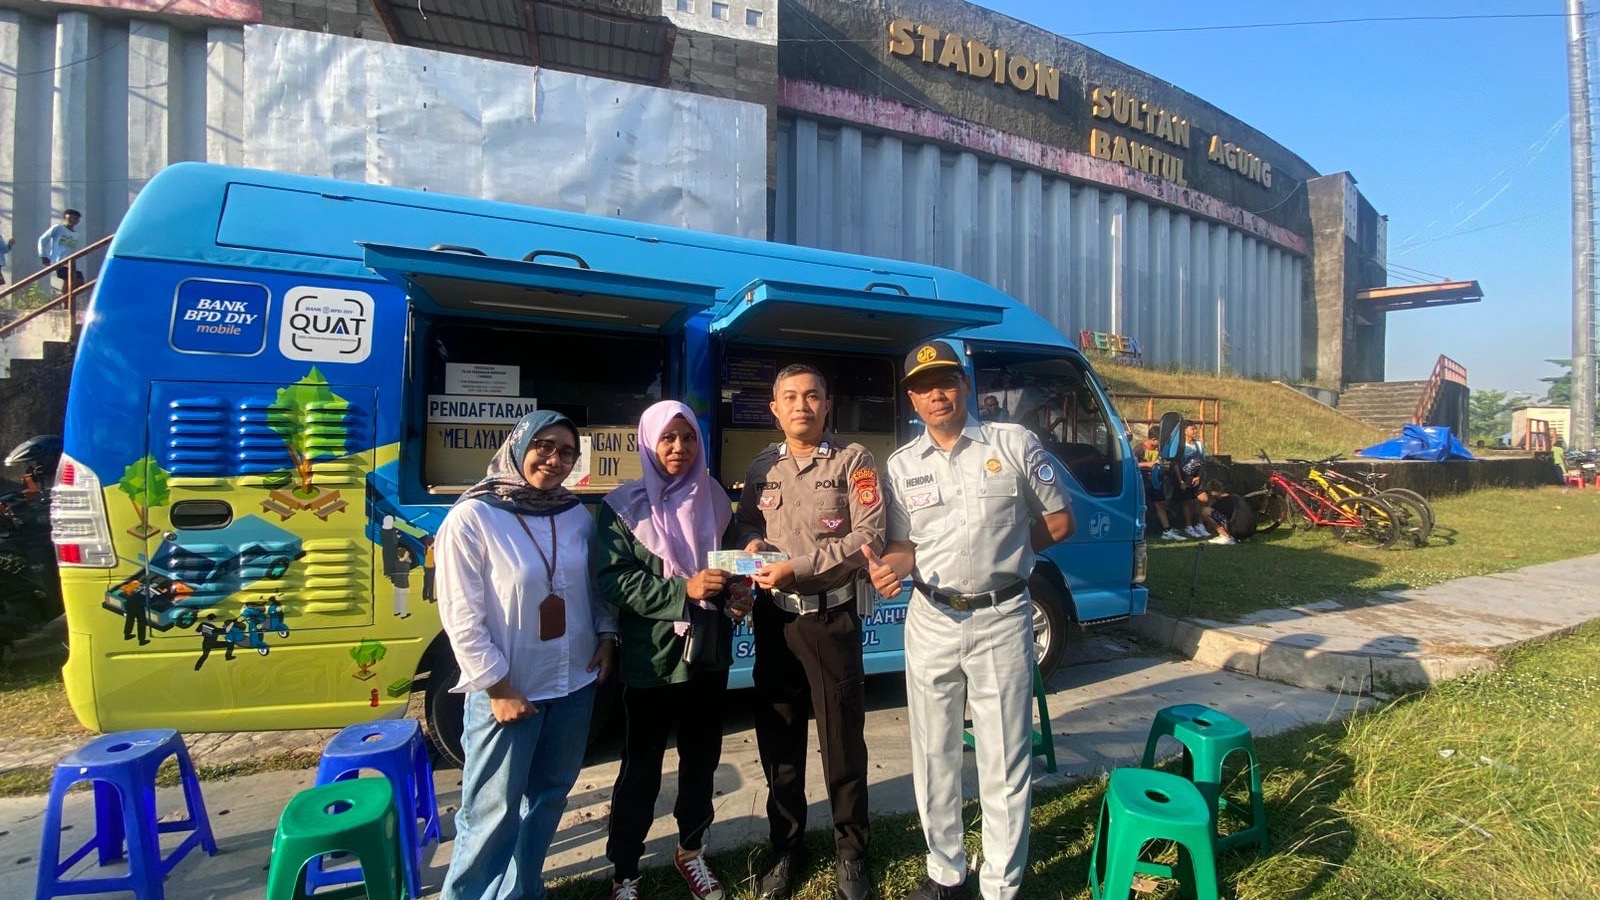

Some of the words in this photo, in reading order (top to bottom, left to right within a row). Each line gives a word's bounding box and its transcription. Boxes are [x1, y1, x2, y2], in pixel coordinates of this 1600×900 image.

[889, 19, 1060, 101] STADION
[1092, 86, 1190, 148] SULTAN
[1208, 134, 1272, 188] AGUNG
[1090, 128, 1188, 186] BANTUL
[196, 298, 249, 312] BANK
[183, 309, 222, 322] BPD
[224, 312, 258, 324] DIY
[289, 313, 366, 336] QUAT
[196, 324, 242, 335] mobile
[430, 400, 534, 419] PENDAFTARAN
[599, 457, 620, 476] DIY
[906, 474, 934, 488] HENDRA
